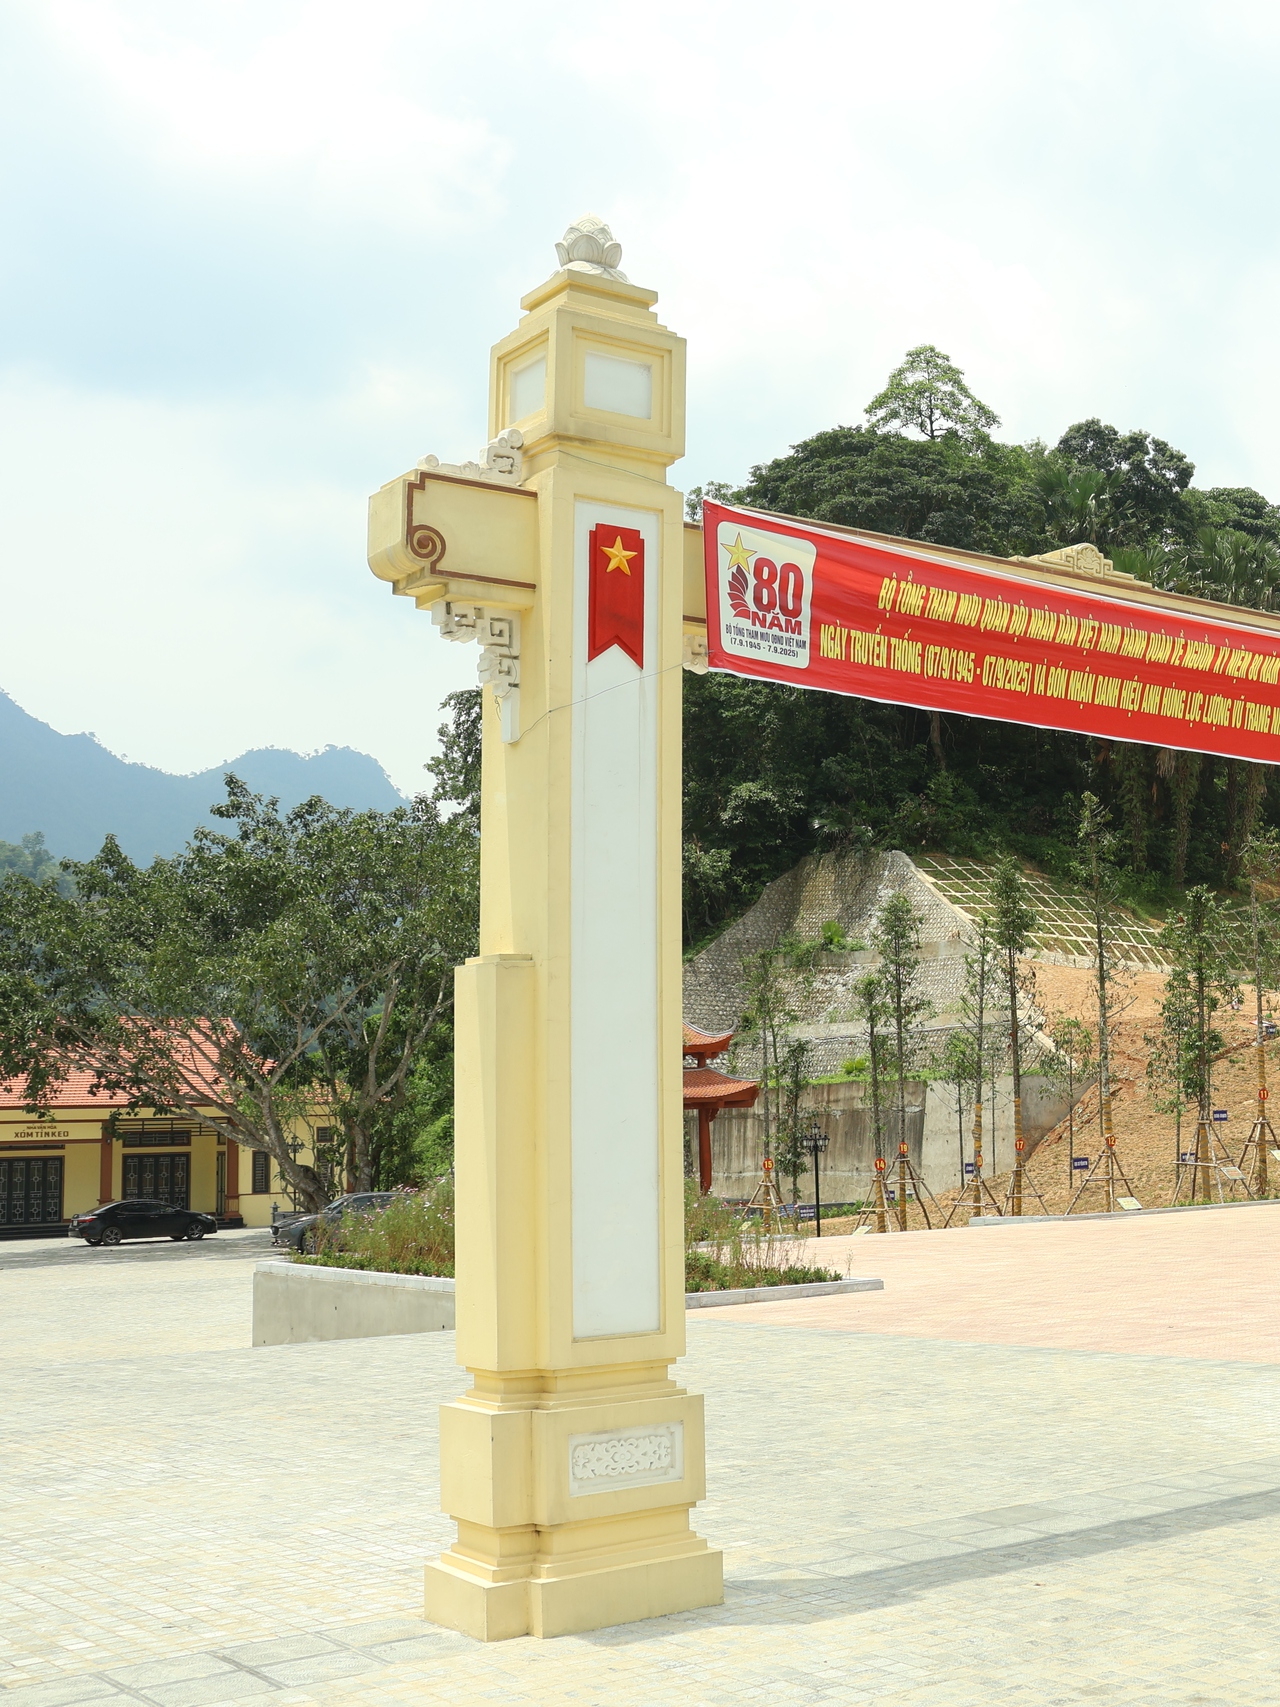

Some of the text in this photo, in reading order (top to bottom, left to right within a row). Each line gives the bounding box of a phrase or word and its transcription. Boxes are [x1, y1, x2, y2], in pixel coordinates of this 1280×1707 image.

[753, 557, 804, 619] 80
[751, 611, 803, 636] NĂM
[878, 571, 897, 618] BỘ
[895, 570, 927, 616] TỔNG
[924, 586, 957, 622] THAM
[954, 593, 982, 627] MƯU
[980, 595, 1010, 632] QUÂN
[1008, 600, 1029, 642] ĐỘI
[1026, 604, 1057, 642] NHÂN
[1055, 609, 1079, 646] DÂN
[1077, 614, 1099, 655] VIỆT
[1097, 622, 1122, 654] NAM
[1119, 621, 1148, 659] HÀNH
[1145, 629, 1173, 664] QUÂN
[1170, 630, 1185, 666] VỀ
[1181, 634, 1216, 672] NGUỒN
[1225, 645, 1253, 684] NIỆM
[1248, 653, 1264, 681] 80
[746, 628, 759, 640] THAM
[795, 639, 807, 650] NAM
[731, 637, 761, 650] (7.9.1945
[767, 644, 798, 658] 7.9.2025)
[820, 619, 848, 661] NGÀY
[890, 628, 922, 675] THỐNG
[923, 644, 975, 684] (07/9/1945
[982, 654, 1032, 696] 07/9/2025)
[1033, 658, 1047, 696] VÀ
[1046, 661, 1069, 699] ĐÓN
[1067, 666, 1096, 709] NHẬN
[1094, 675, 1122, 708] DANH
[1120, 675, 1143, 717] HIỆU
[1140, 683, 1162, 715] ANH
[1160, 682, 1186, 719] HÙNG
[1184, 690, 1204, 727] LỰC
[1202, 693, 1232, 731] LƯỢNG
[1231, 695, 1245, 729] VŨ
[1243, 701, 1271, 733] TRANG
[1260, 1090, 1267, 1098] 11
[14, 1129, 33, 1138] XÓM
[1107, 1136, 1115, 1144] 12
[900, 1144, 908, 1152] 19
[1016, 1141, 1024, 1149] 17
[764, 1160, 773, 1169] 15
[876, 1160, 885, 1169] 14
